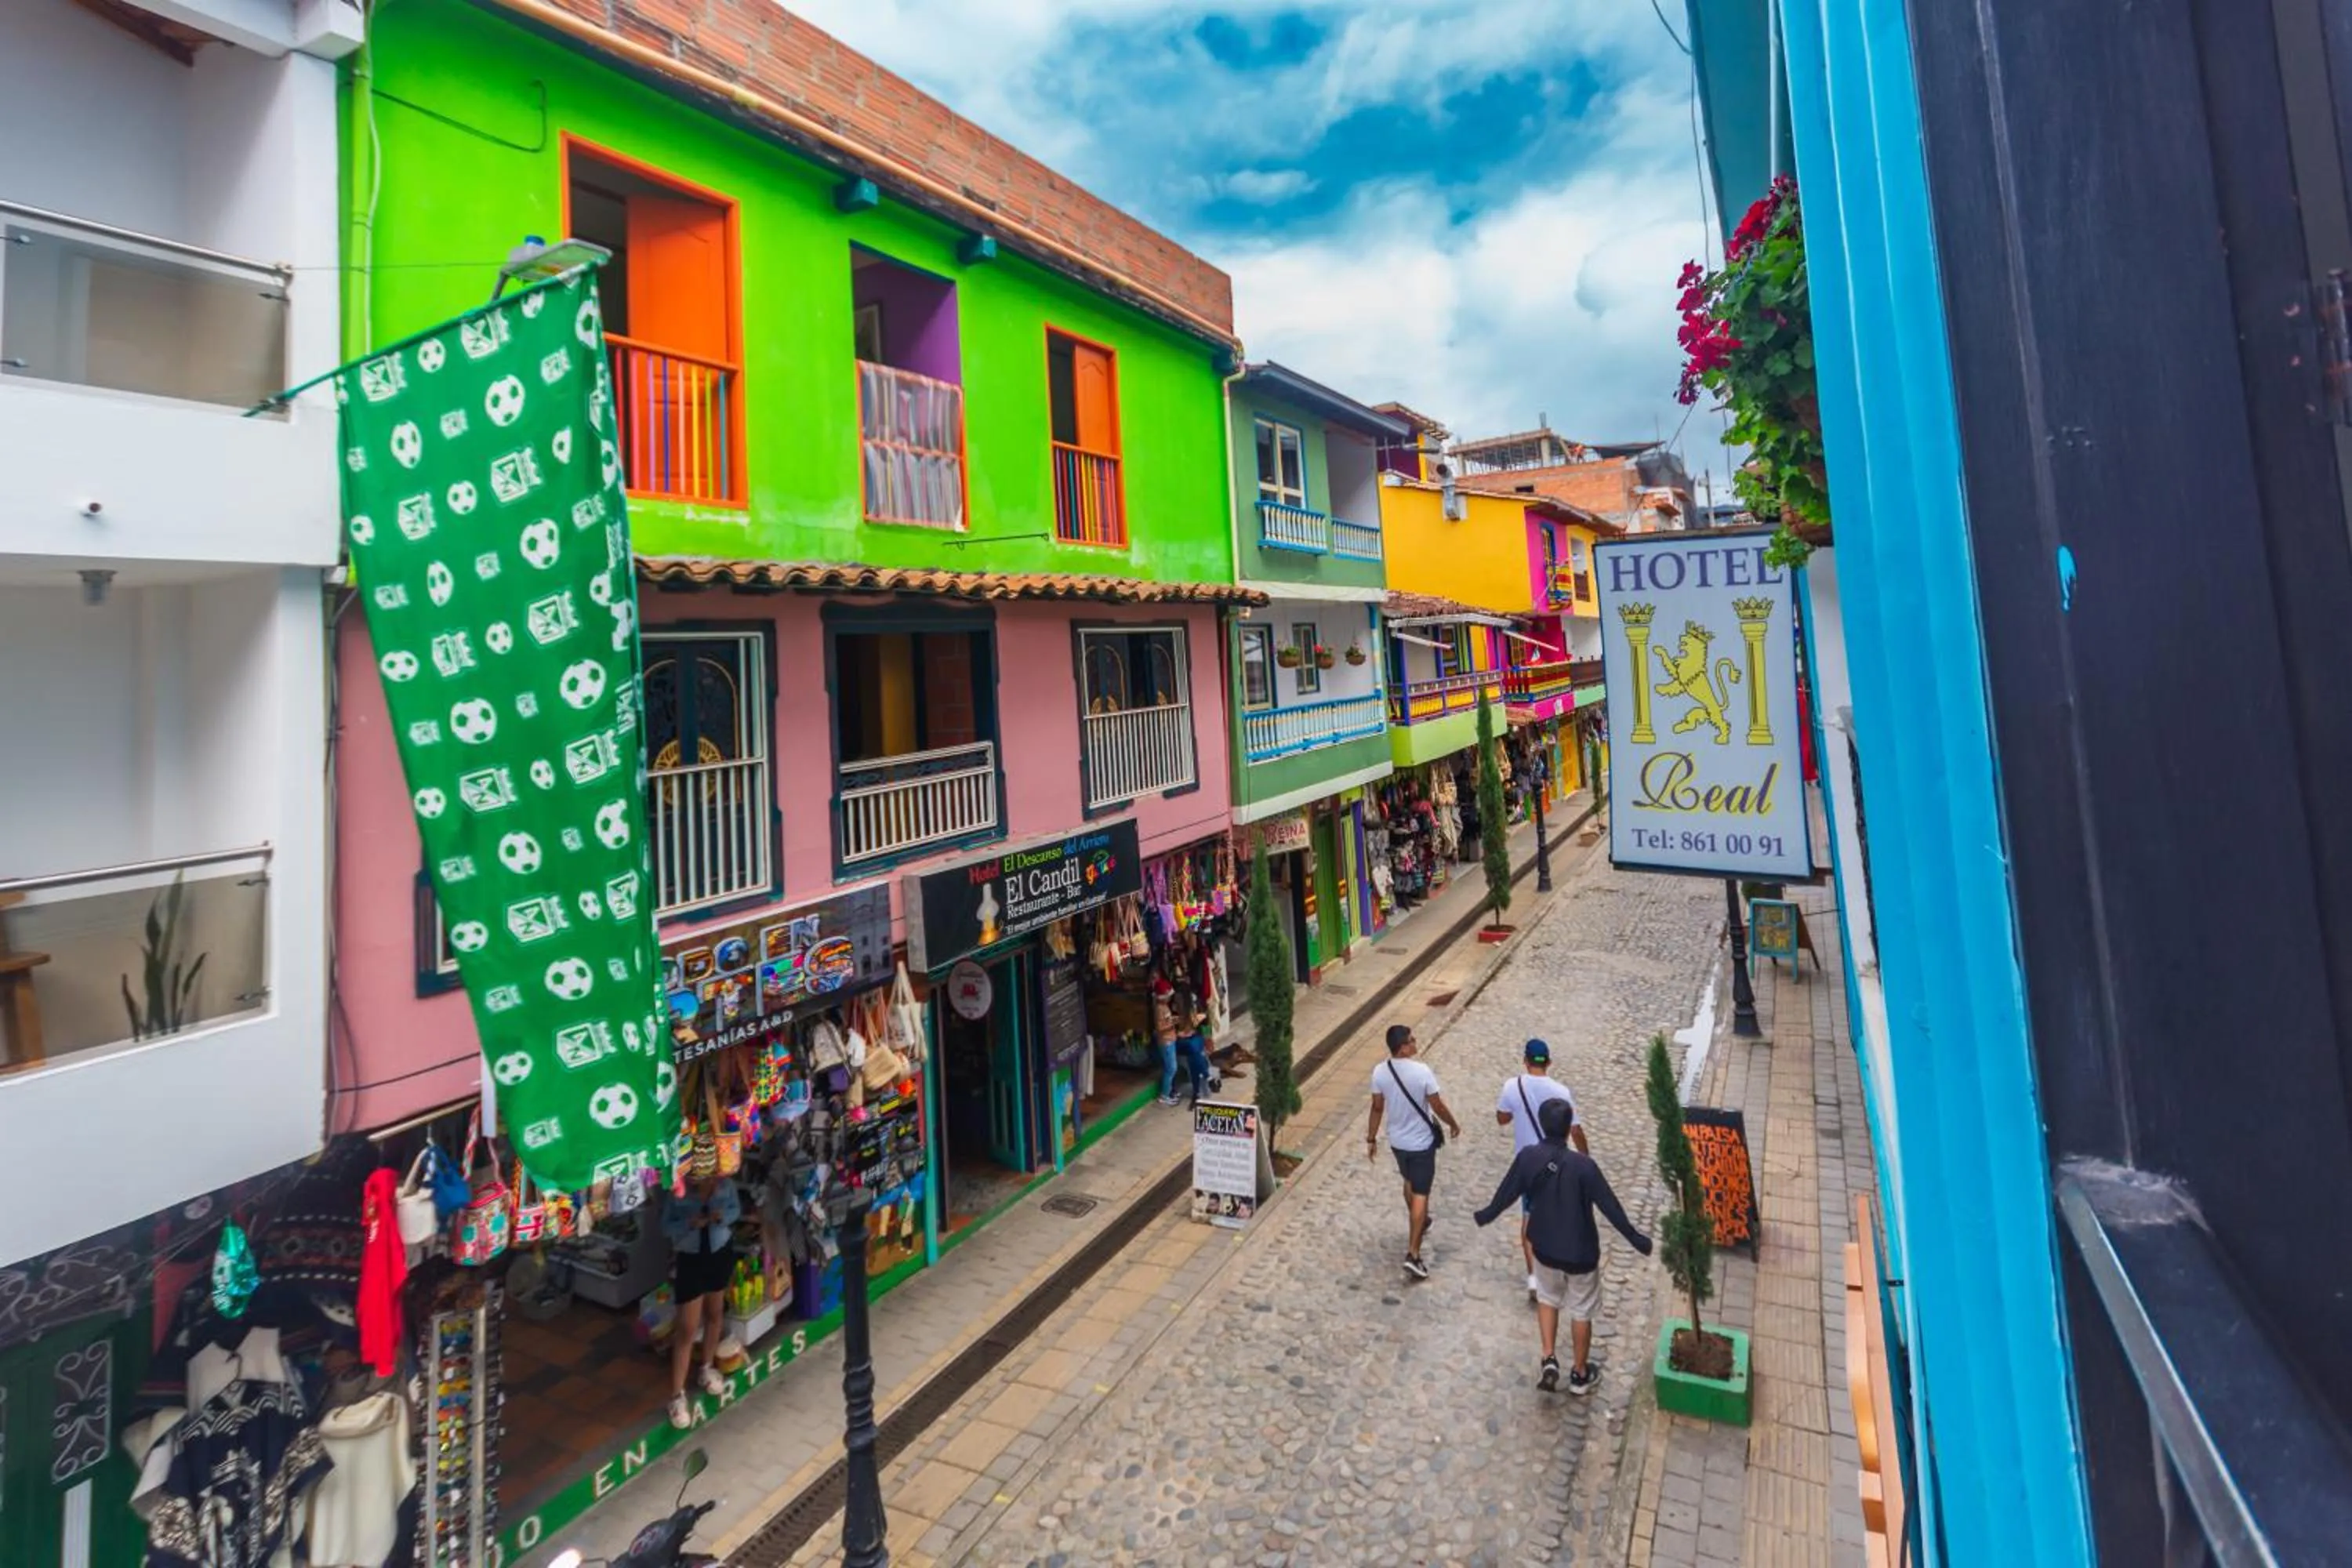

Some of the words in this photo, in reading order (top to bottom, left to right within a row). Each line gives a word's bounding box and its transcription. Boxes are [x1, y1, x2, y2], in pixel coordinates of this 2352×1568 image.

[1608, 547, 1784, 592] HOTEL
[1632, 752, 1778, 815] Real
[1004, 851, 1014, 873] El
[1017, 847, 1062, 869] Descanso
[1631, 828, 1675, 850] Tel:
[1681, 831, 1719, 853] 861
[1726, 833, 1752, 855] 00
[1758, 835, 1786, 857] 91
[1004, 873, 1025, 904] El
[1029, 857, 1081, 896] Candil
[1007, 892, 1059, 920] Restaurante
[1066, 884, 1082, 899] Bar
[760, 913, 821, 964] EN
[673, 1021, 757, 1064] TESANÍAS
[593, 1438, 648, 1499] EN
[690, 1330, 807, 1430] ARTES
